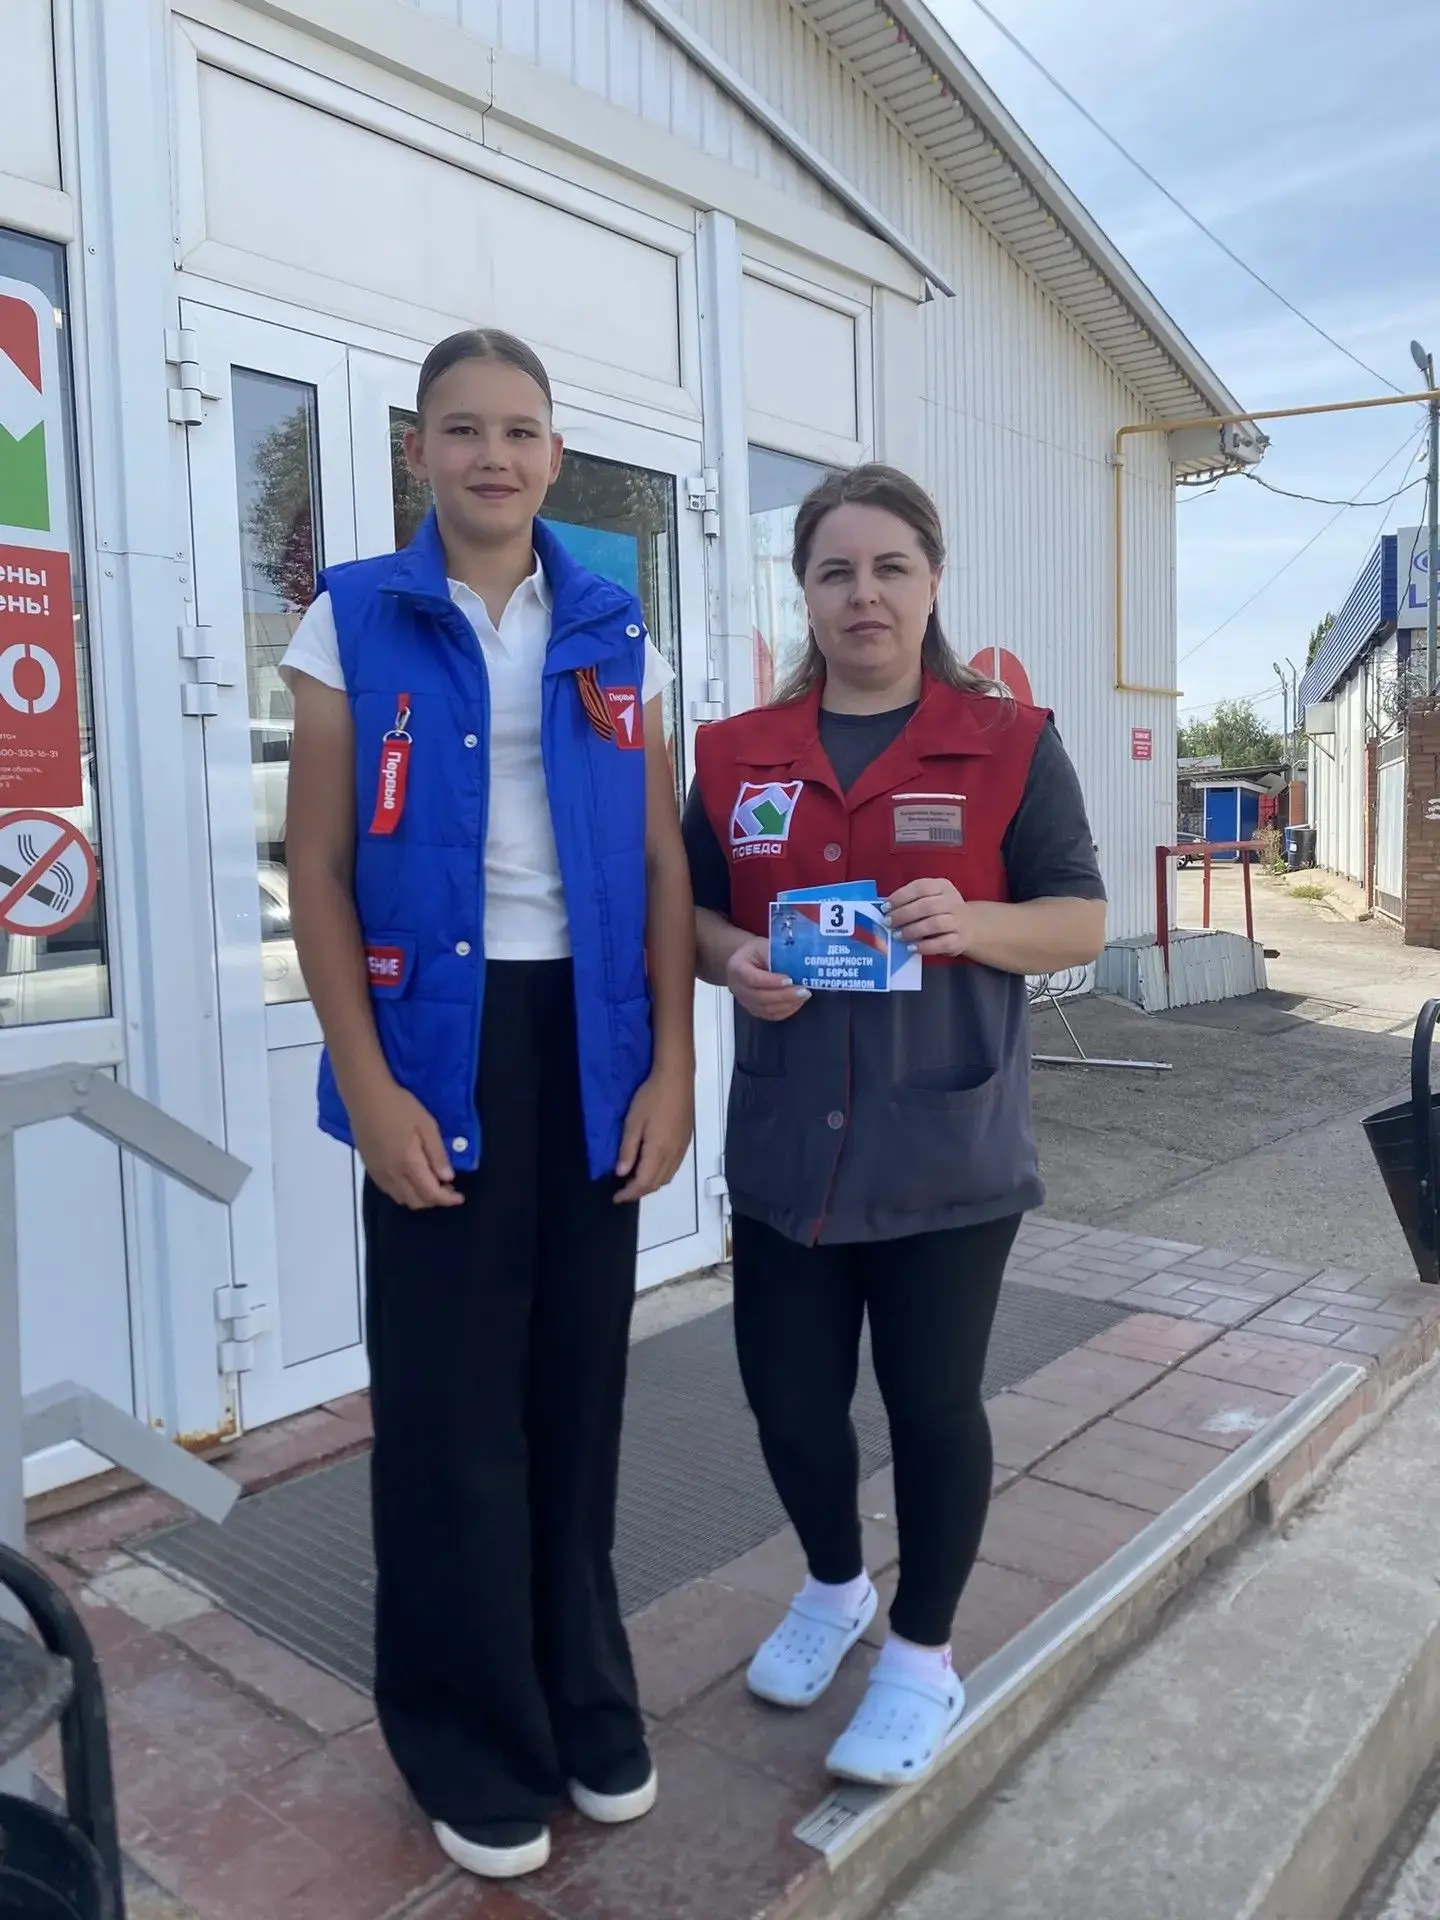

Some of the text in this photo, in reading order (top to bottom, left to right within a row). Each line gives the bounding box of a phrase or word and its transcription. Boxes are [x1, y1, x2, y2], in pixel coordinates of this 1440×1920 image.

[0, 748, 58, 758] 00-333-16-31
[830, 904, 844, 927] 3
[827, 945, 851, 955] ДЕНЬ
[804, 956, 873, 967] СОЛИДАРНОСТИ
[818, 968, 859, 978] В БОРЬБЕ
[802, 978, 875, 989] С ТЕРРОРИЗМОМ
